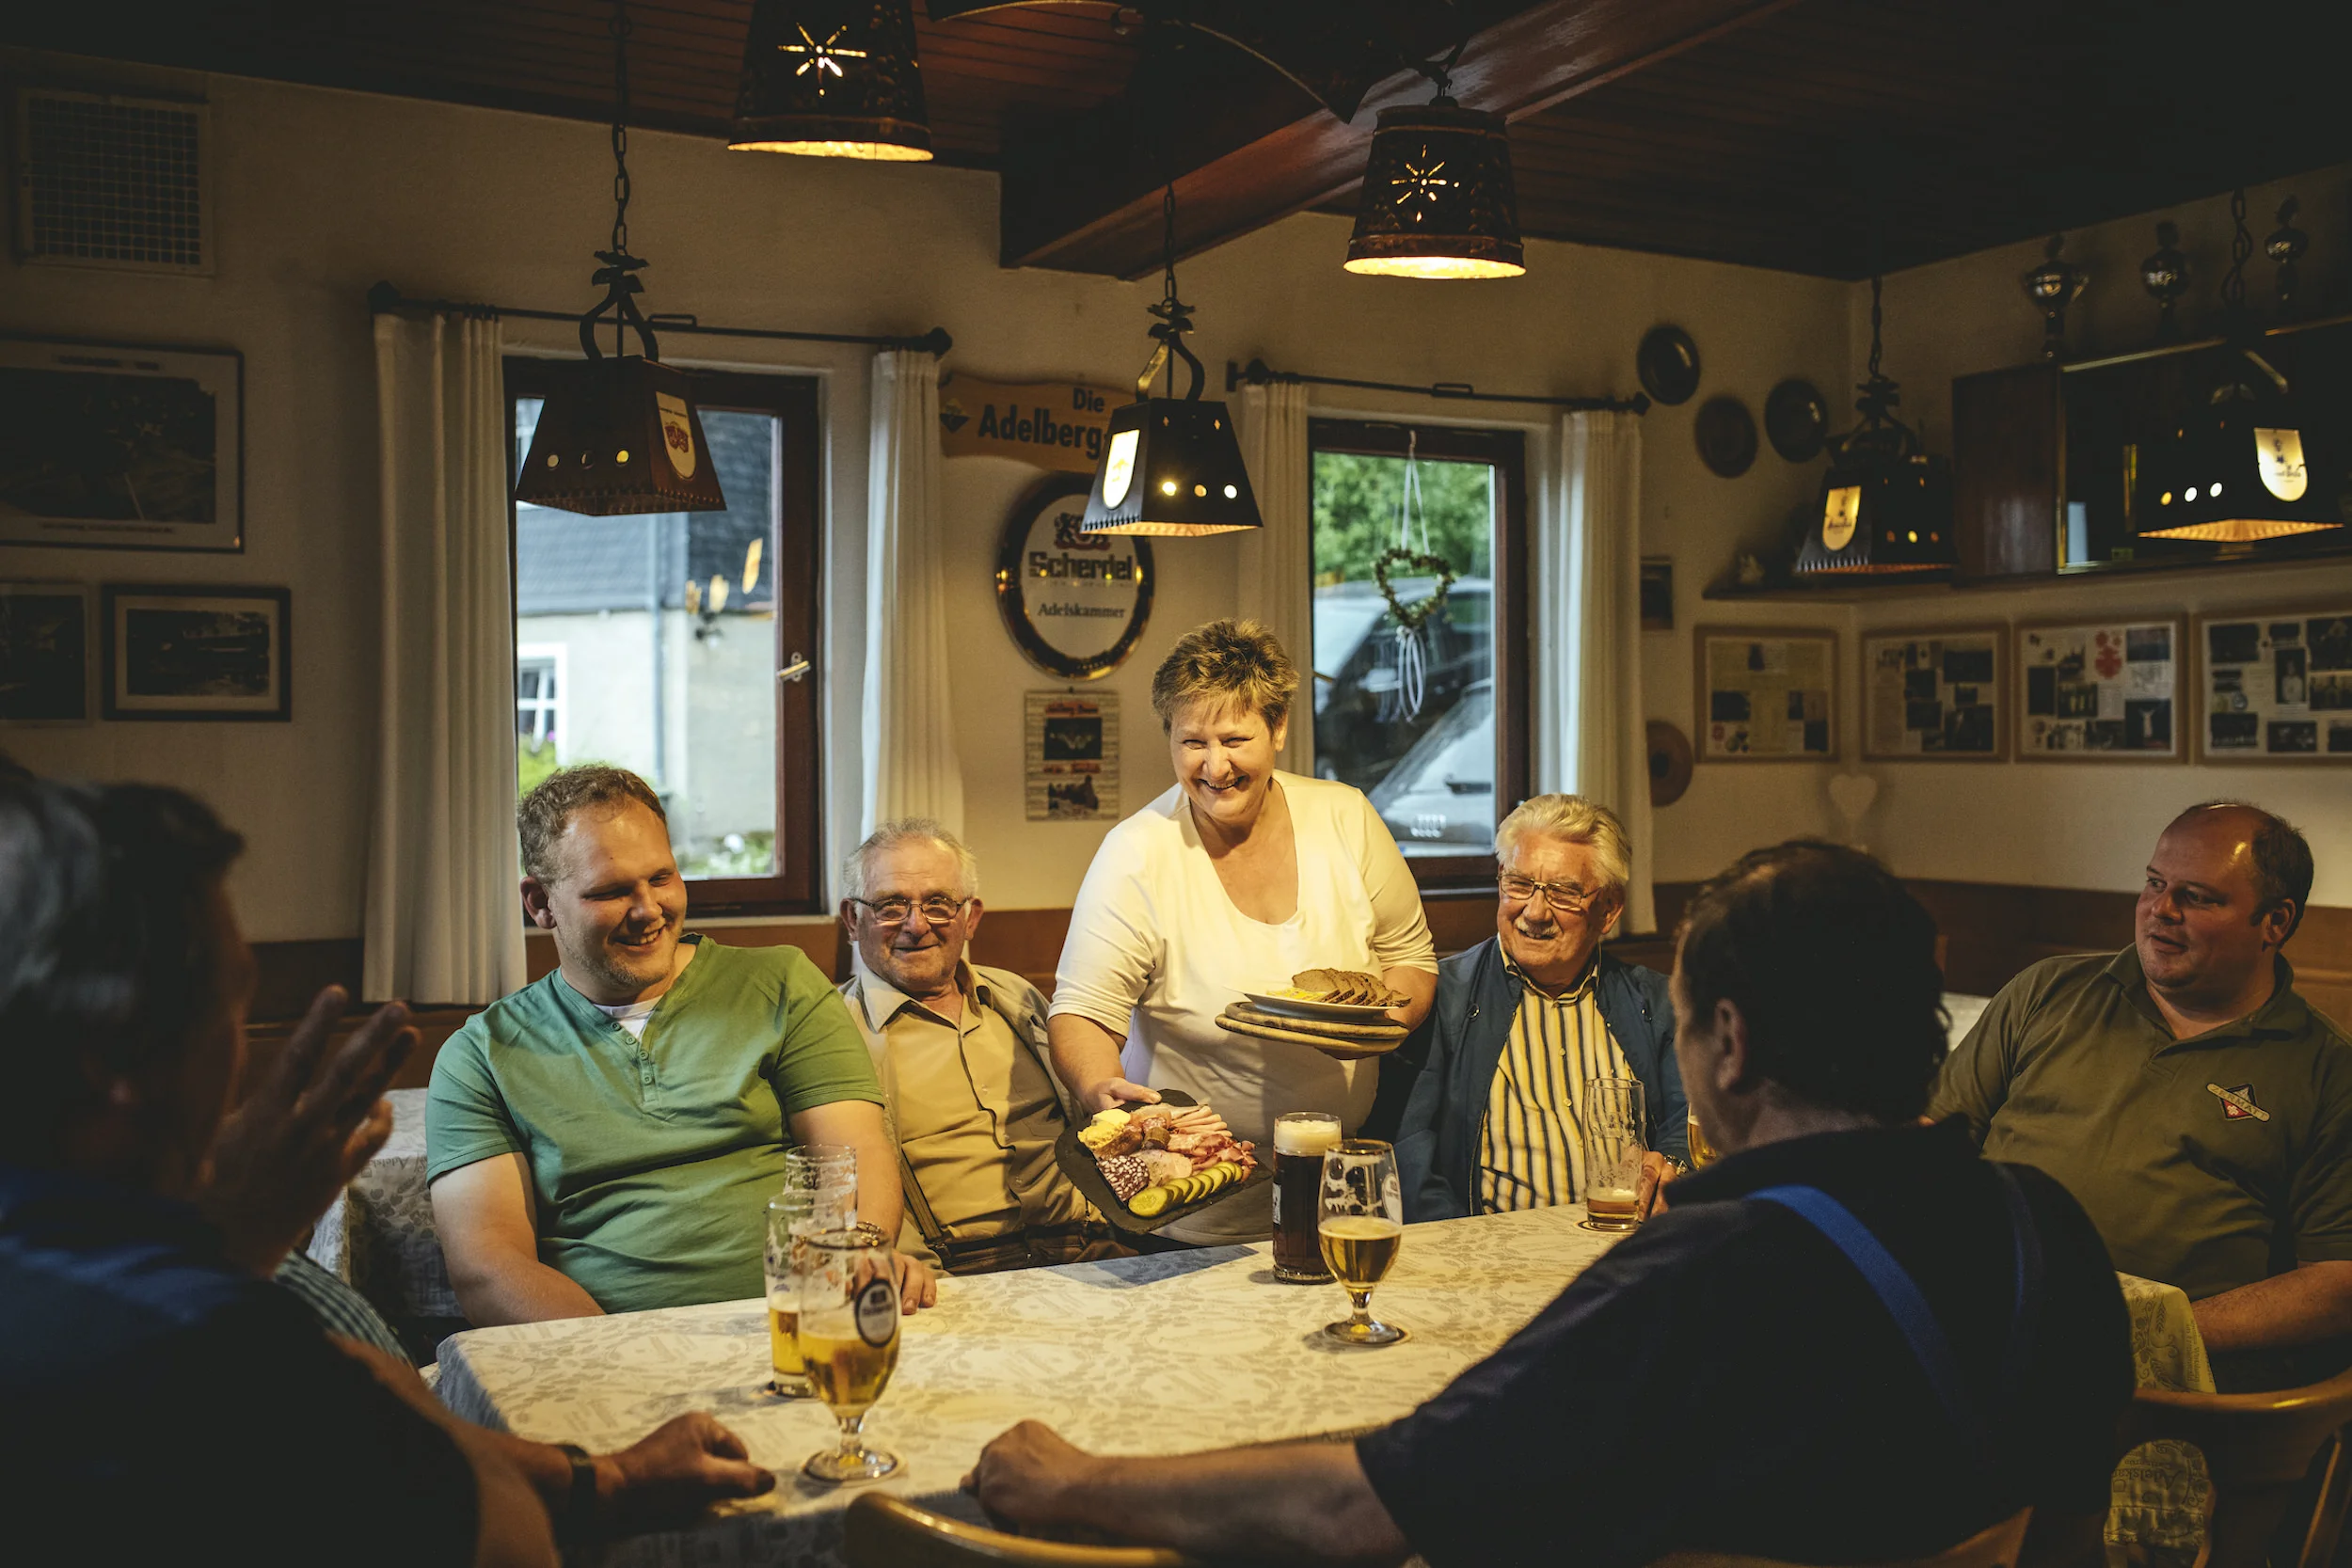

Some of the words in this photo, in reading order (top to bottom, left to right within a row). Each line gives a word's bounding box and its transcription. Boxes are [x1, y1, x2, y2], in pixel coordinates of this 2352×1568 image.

[1073, 387, 1104, 413] Die
[978, 404, 1105, 460] Adelberg
[2211, 1086, 2268, 1120] ZERMATT
